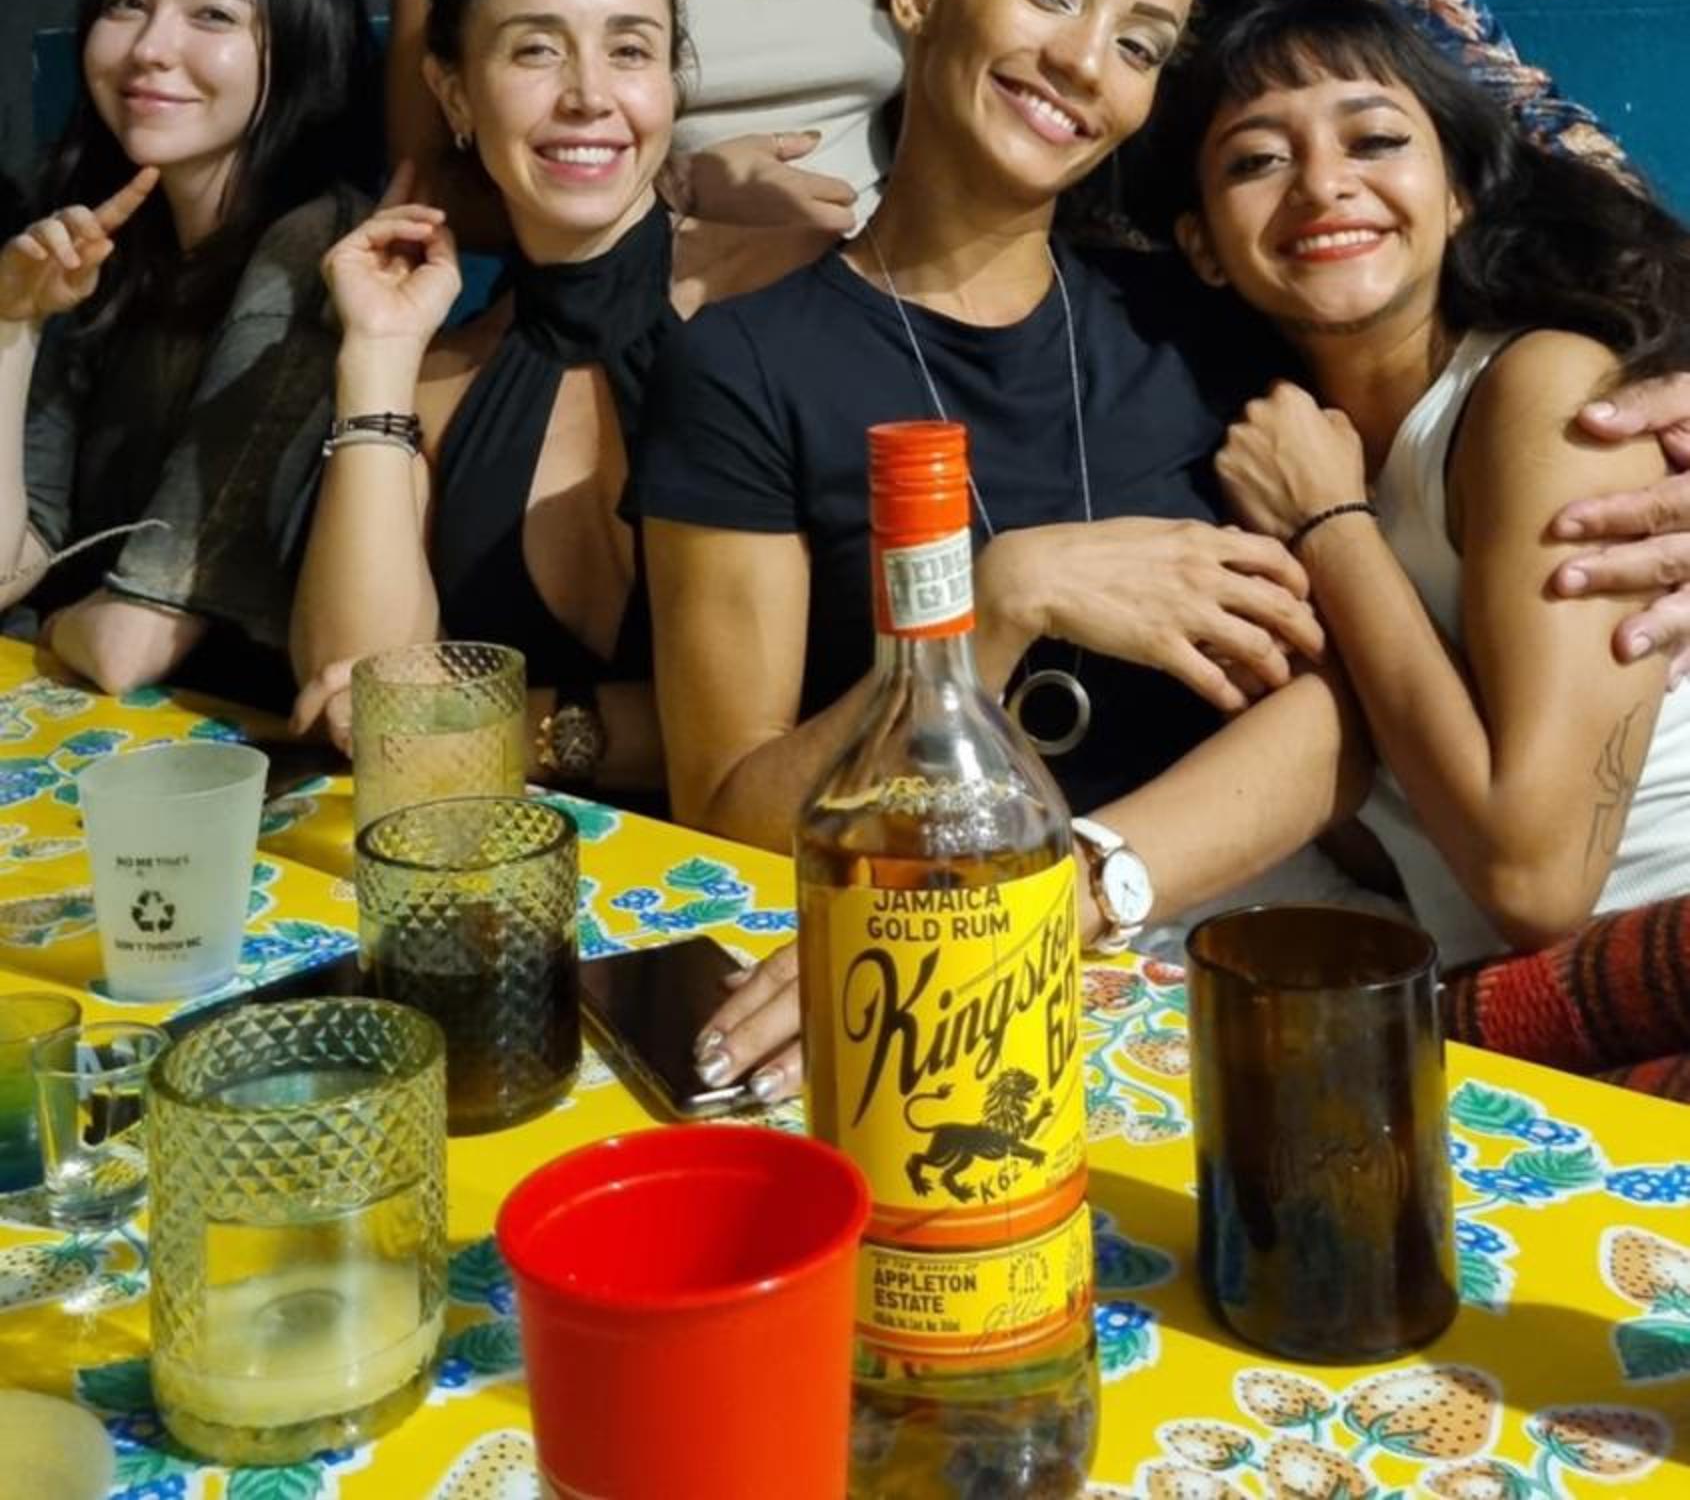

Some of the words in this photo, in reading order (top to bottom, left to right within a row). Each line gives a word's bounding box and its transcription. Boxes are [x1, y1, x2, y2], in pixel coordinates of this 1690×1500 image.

[873, 886, 1002, 913] JAMAICA
[867, 915, 941, 941] GOLD
[952, 910, 1011, 941] RUM
[873, 1267, 977, 1293] APPLETON
[873, 1288, 945, 1314] ESTATE
